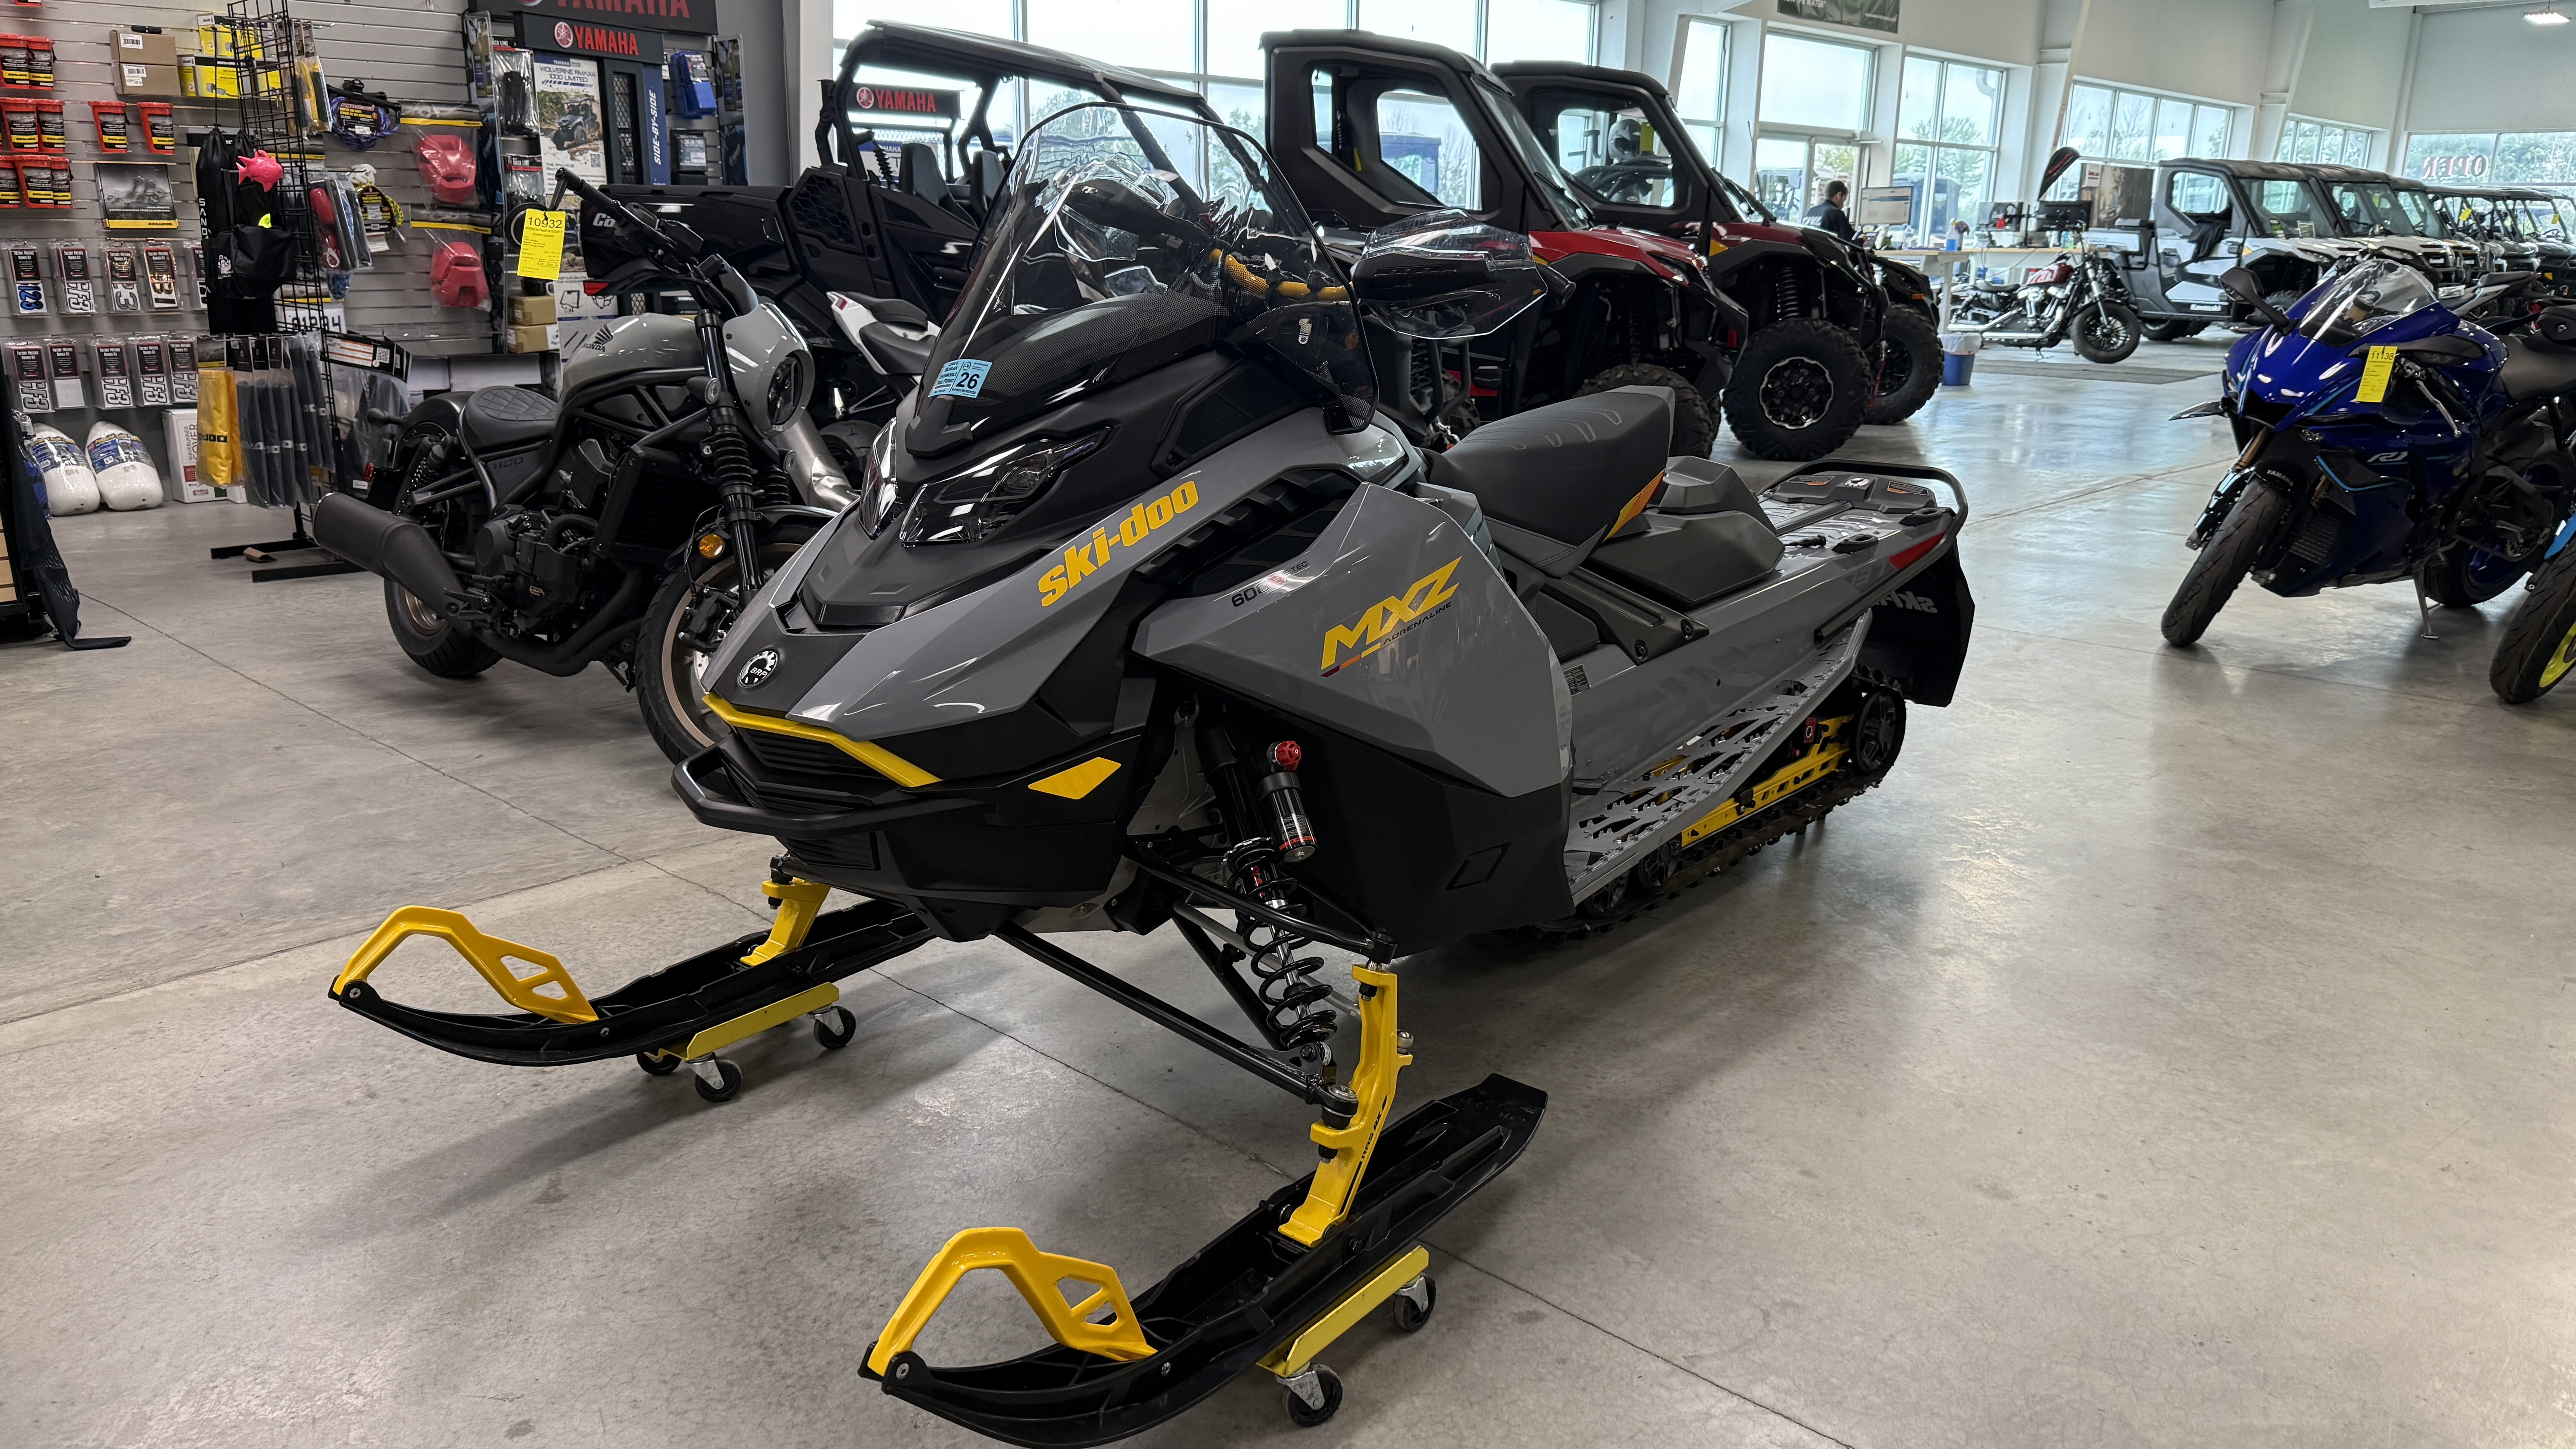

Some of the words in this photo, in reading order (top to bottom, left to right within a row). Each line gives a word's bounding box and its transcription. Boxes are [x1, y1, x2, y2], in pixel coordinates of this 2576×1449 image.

[574, 25, 639, 56] YAMAHA
[539, 66, 573, 75] WOLVERINE
[875, 89, 937, 112] YAMAHA
[649, 89, 661, 166] SIDE-BY-SIDE
[527, 216, 562, 229] 10932
[581, 343, 606, 352] HONDA
[2371, 352, 2394, 360] 11138
[956, 372, 980, 389] 26
[493, 456, 523, 470] 1100
[2266, 469, 2294, 487] YAMAHA
[1038, 481, 1199, 607] ski-doo
[1321, 555, 1463, 670] MXZ
[1383, 601, 1452, 645] ADRENALINE
[750, 667, 768, 677] BRP
